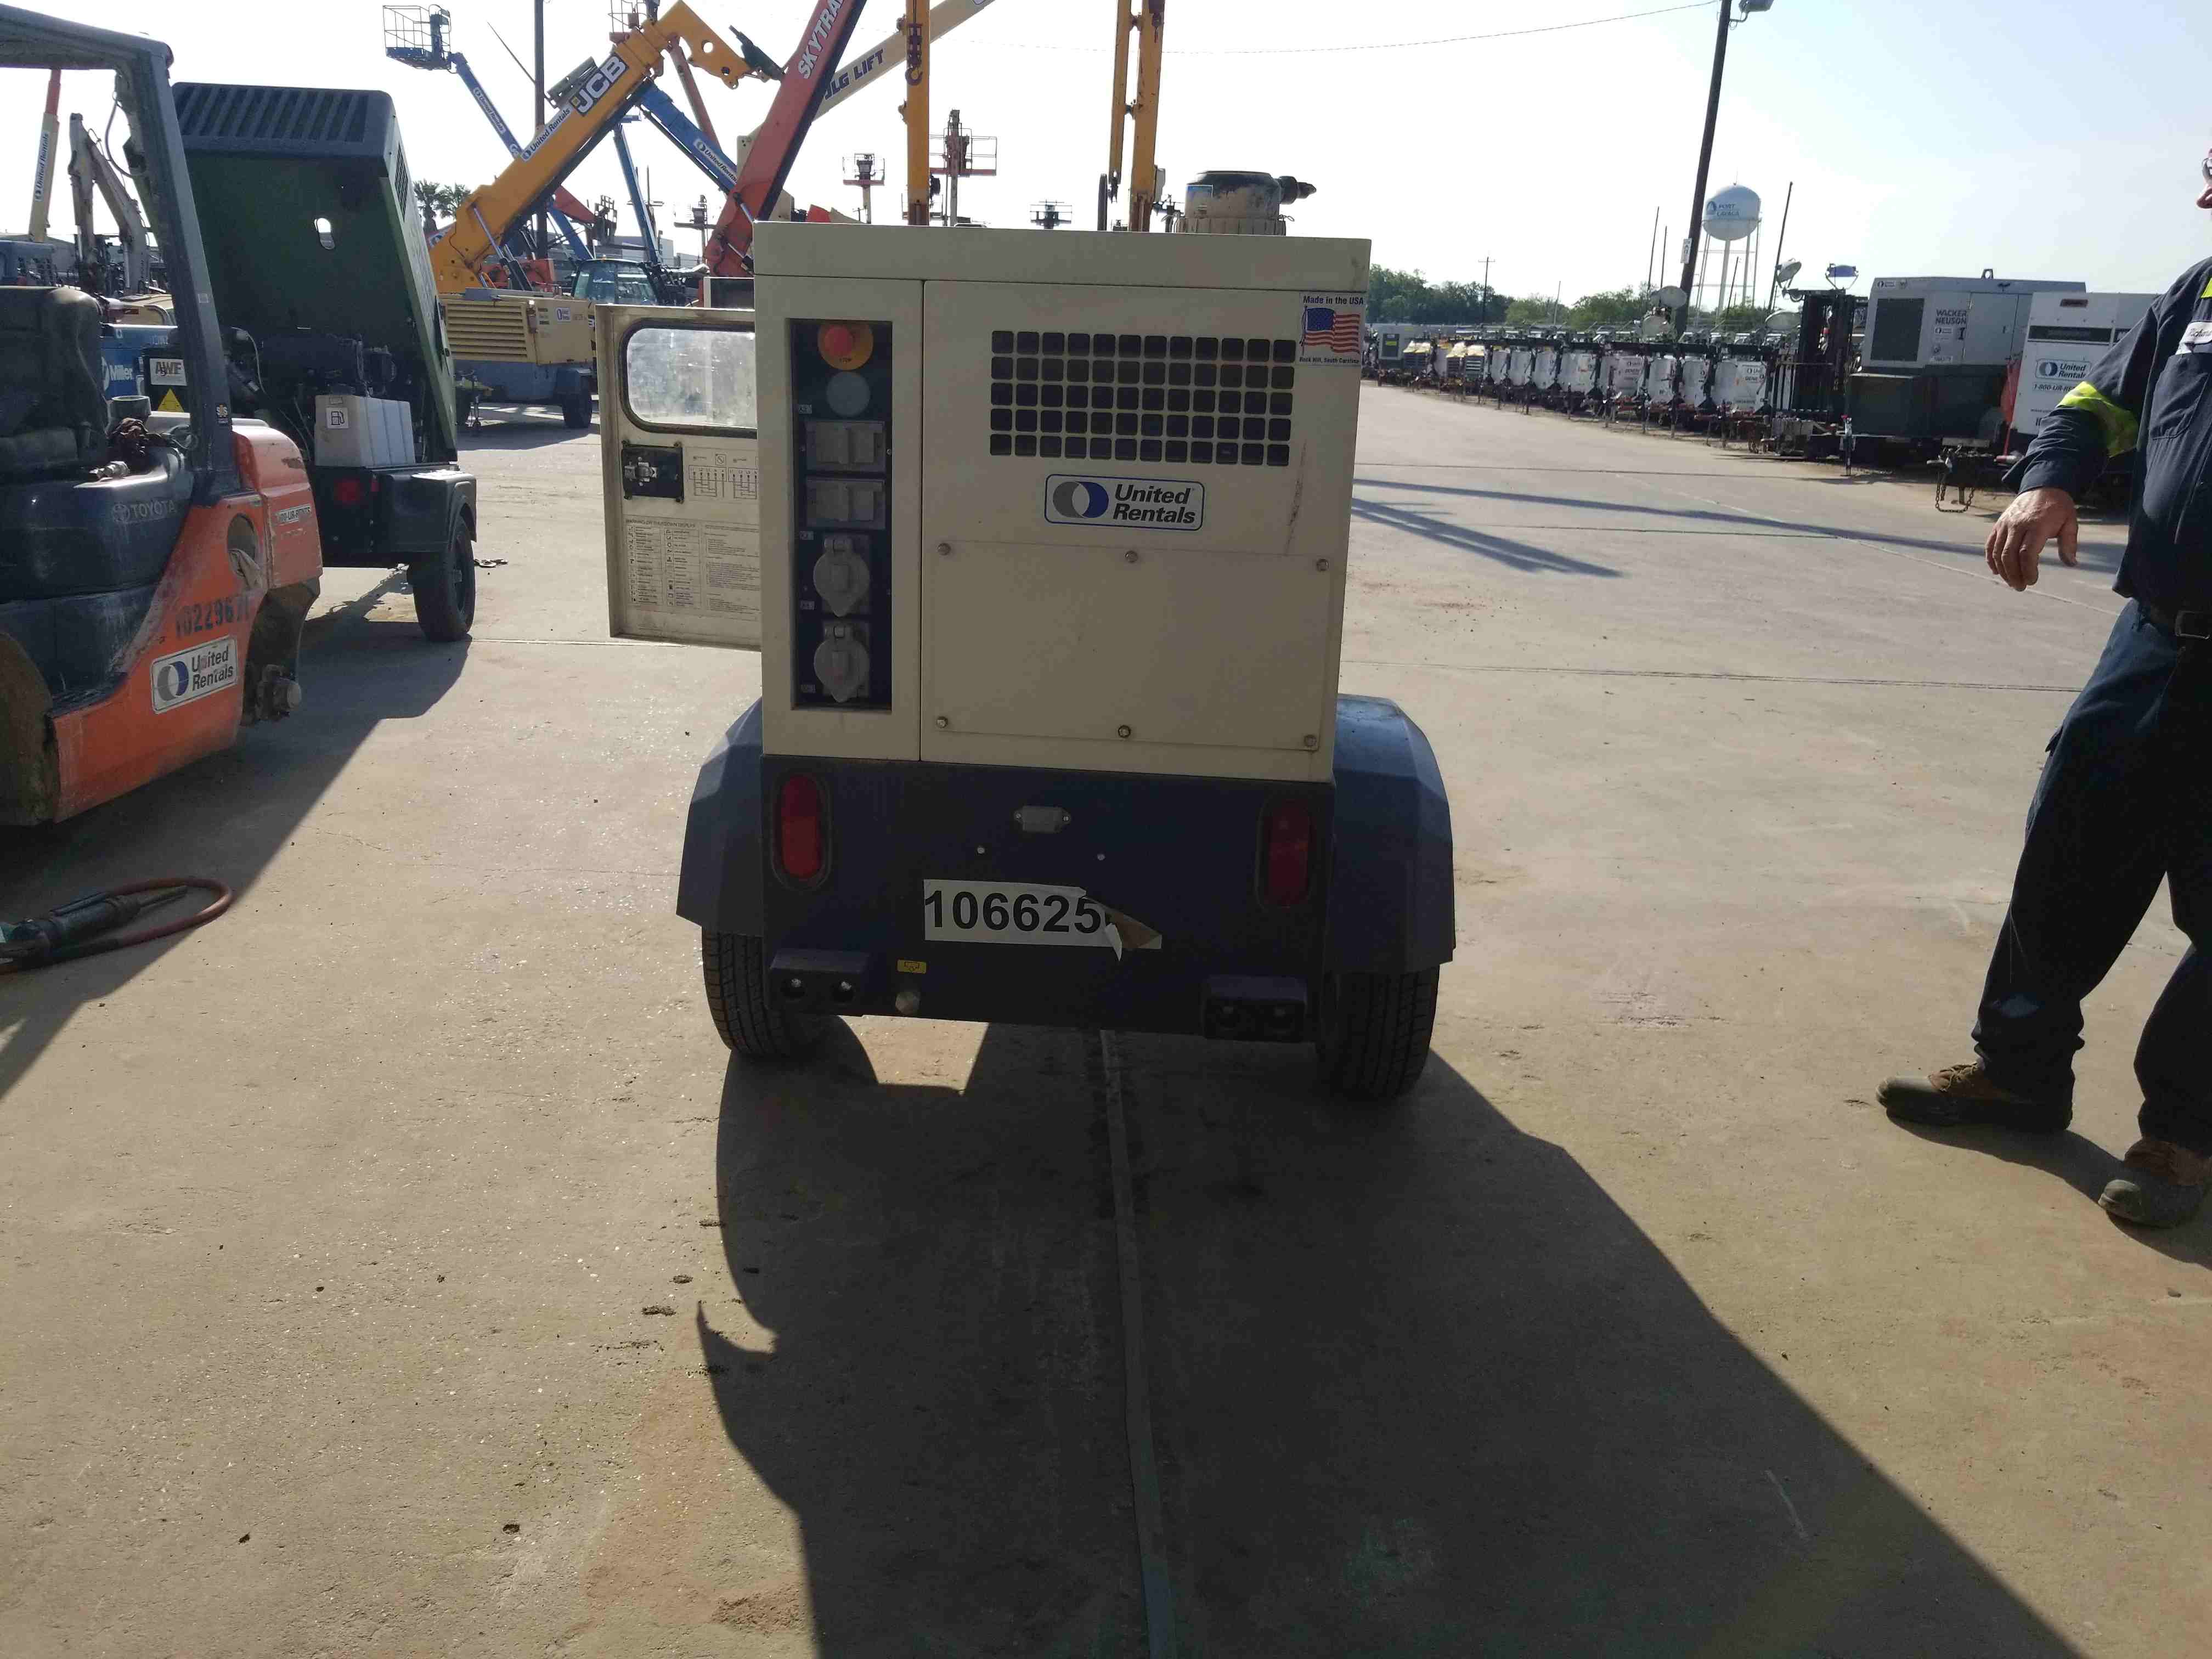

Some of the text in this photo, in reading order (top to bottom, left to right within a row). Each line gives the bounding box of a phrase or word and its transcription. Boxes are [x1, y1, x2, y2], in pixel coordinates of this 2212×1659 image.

[854, 49, 884, 80] LIFT
[577, 56, 627, 113] JCB
[530, 108, 571, 150] United Rentals
[704, 149, 723, 167] United
[1303, 295, 1364, 305] Made in the USA
[1936, 308, 1967, 317] WACKER
[1936, 317, 1967, 325] NEUSON
[109, 364, 133, 381] Miller
[2059, 363, 2086, 372] United
[1115, 483, 1191, 505] United
[130, 500, 178, 518] TOYOTA
[1112, 503, 1196, 524] Rentals
[192, 665, 234, 691] Rentals
[925, 890, 1111, 934] 106625
